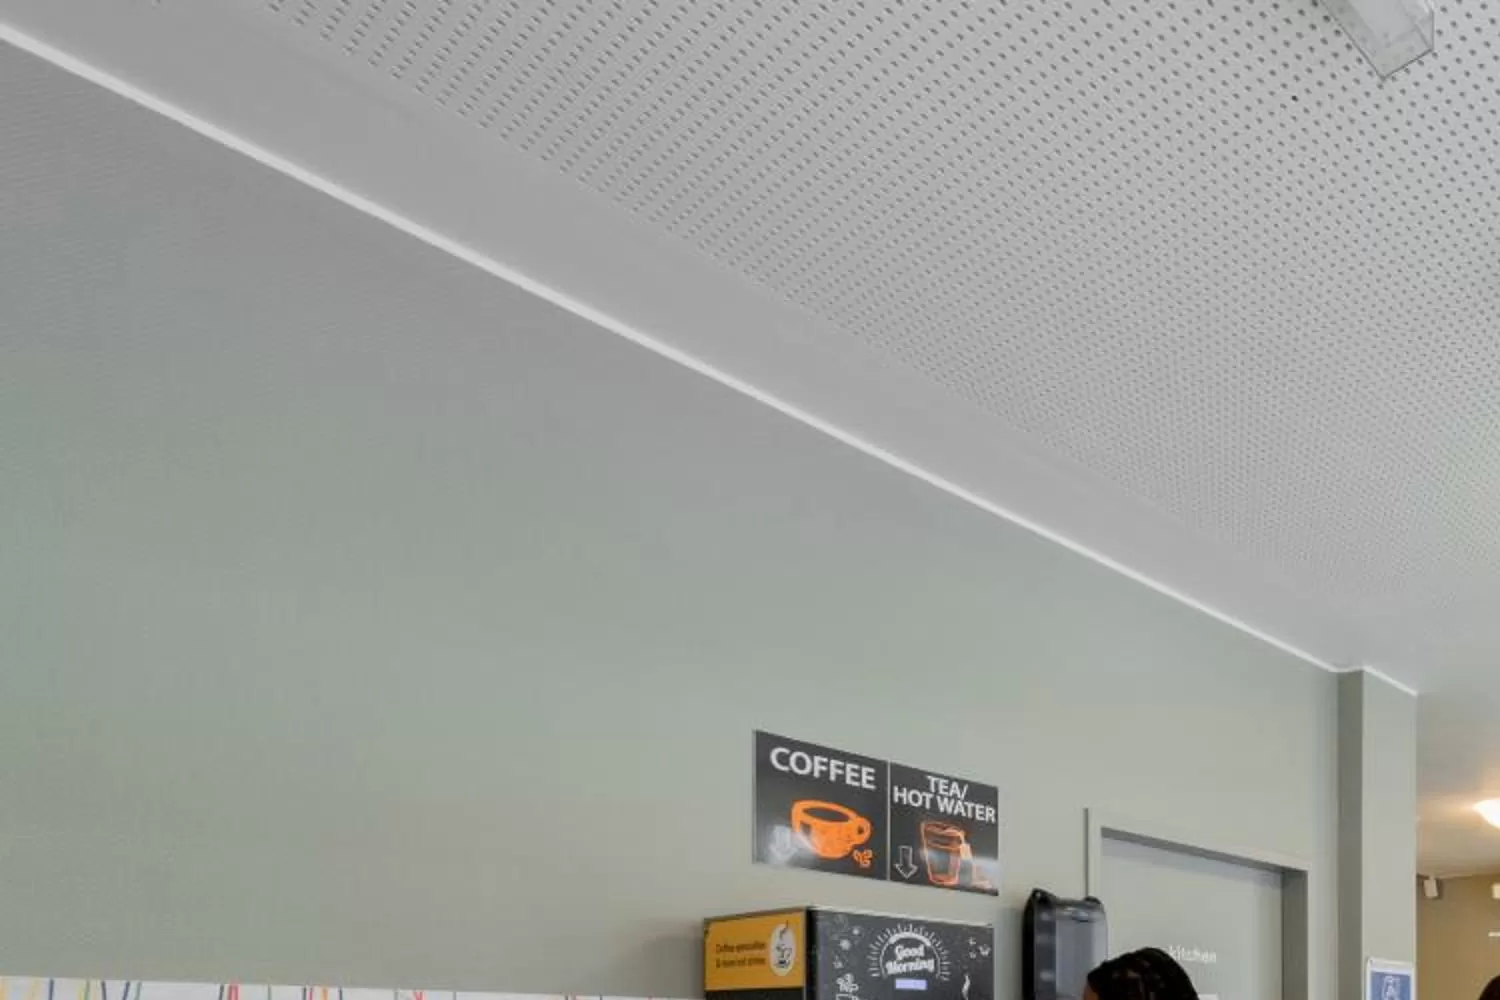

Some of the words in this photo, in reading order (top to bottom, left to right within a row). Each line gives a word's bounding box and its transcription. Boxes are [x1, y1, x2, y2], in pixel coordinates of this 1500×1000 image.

[769, 747, 876, 790] COFFEE
[926, 775, 969, 798] TEA/
[893, 785, 934, 810] HOT
[936, 796, 997, 824] WATER
[895, 944, 925, 960] Good
[885, 959, 935, 976] Morning
